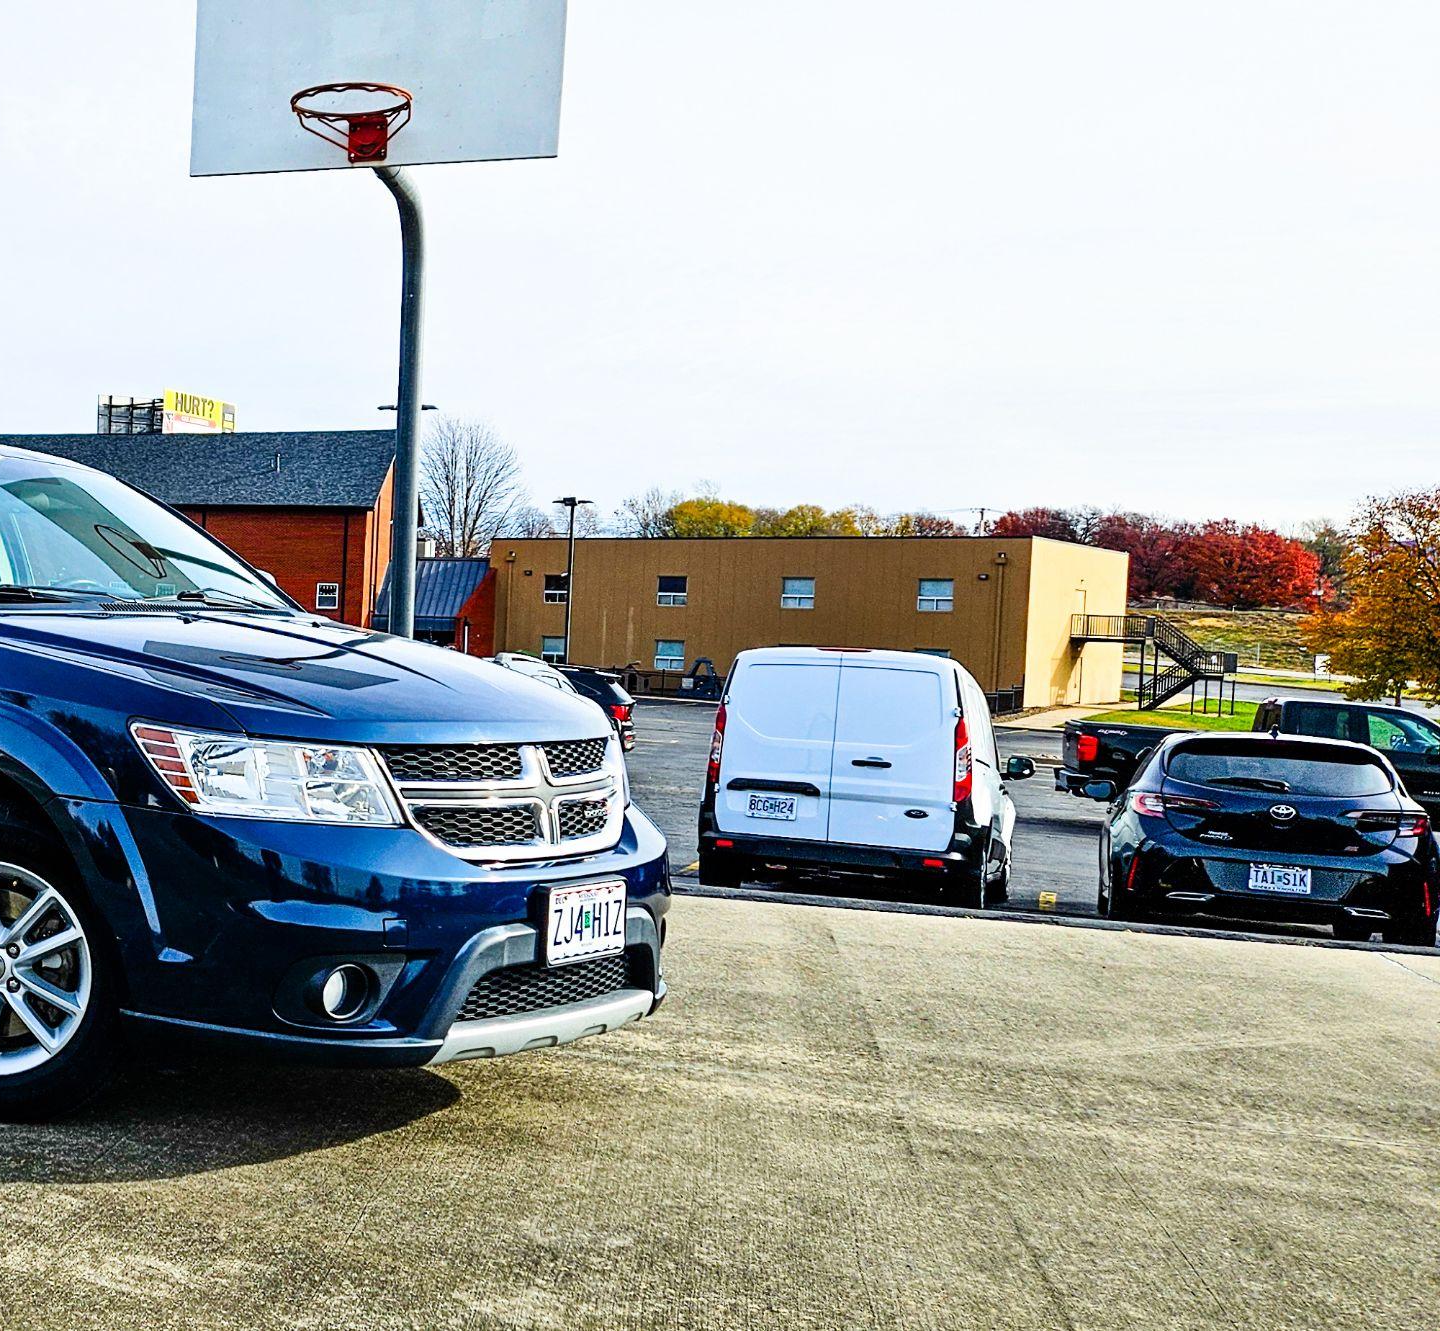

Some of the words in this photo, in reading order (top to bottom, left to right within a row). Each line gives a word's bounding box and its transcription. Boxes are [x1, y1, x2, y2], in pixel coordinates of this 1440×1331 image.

[175, 391, 215, 419] HURT?
[749, 798, 769, 812] 8CG
[773, 800, 794, 815] H24
[1282, 872, 1307, 888] S1K
[553, 904, 585, 947] ZJ4
[592, 900, 623, 940] H1Z
